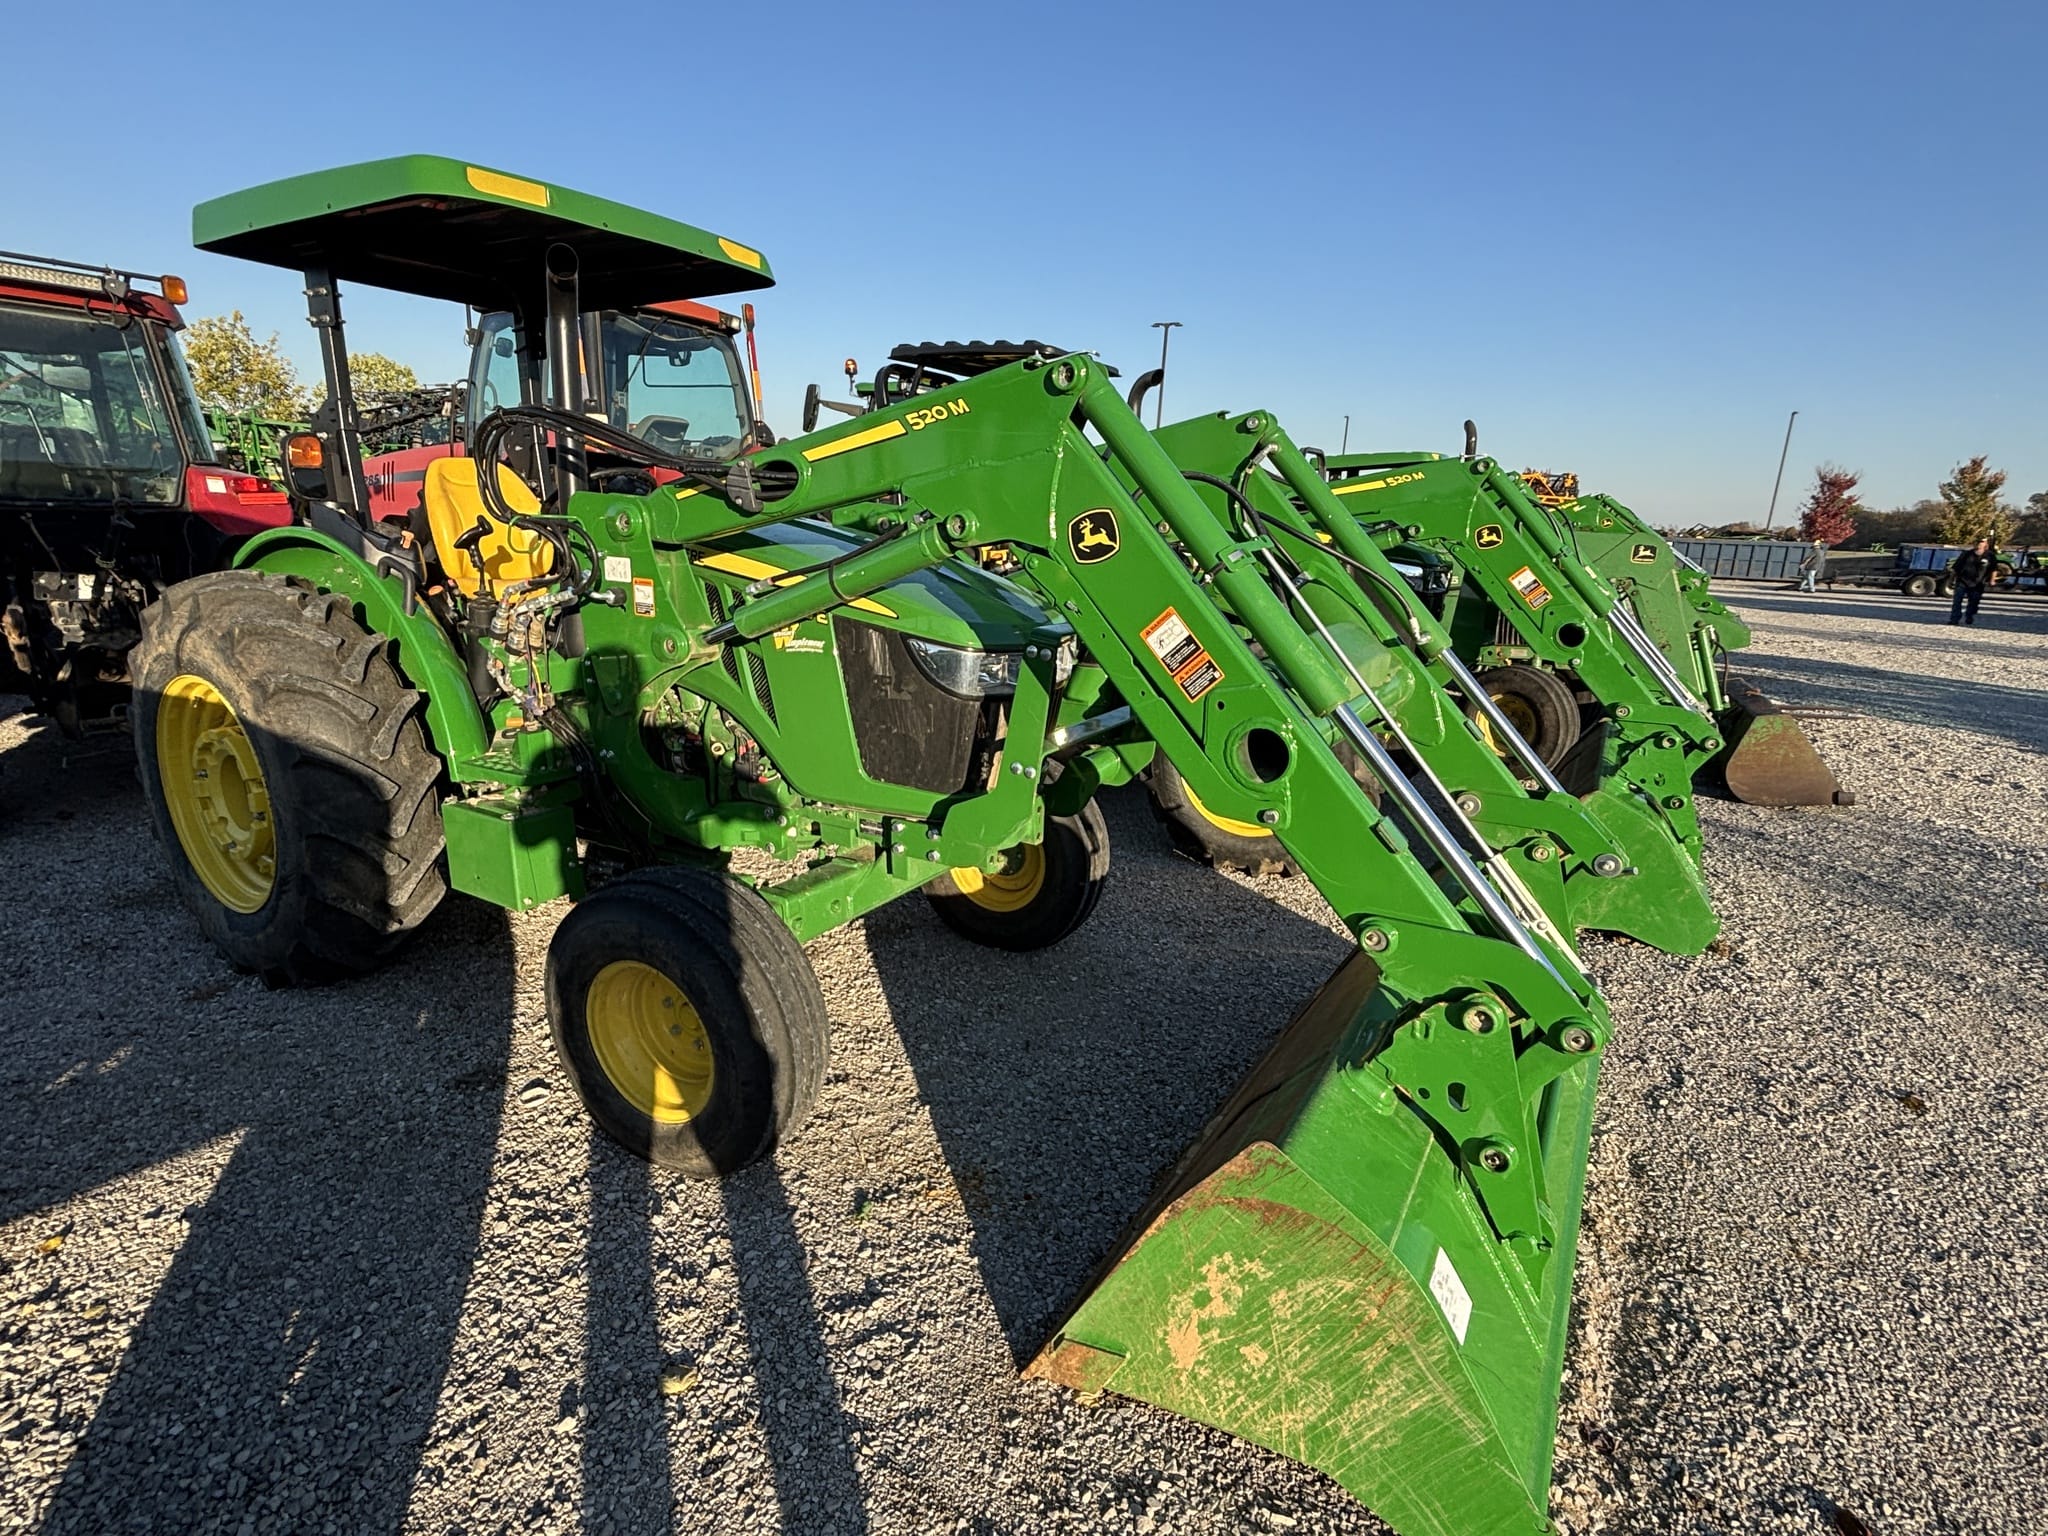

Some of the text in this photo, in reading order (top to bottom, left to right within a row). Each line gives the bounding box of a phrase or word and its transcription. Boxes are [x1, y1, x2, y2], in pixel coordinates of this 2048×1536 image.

[905, 398, 970, 430] 520 M
[1385, 471, 1425, 486] 520 M
[1183, 656, 1206, 676] WARNING
